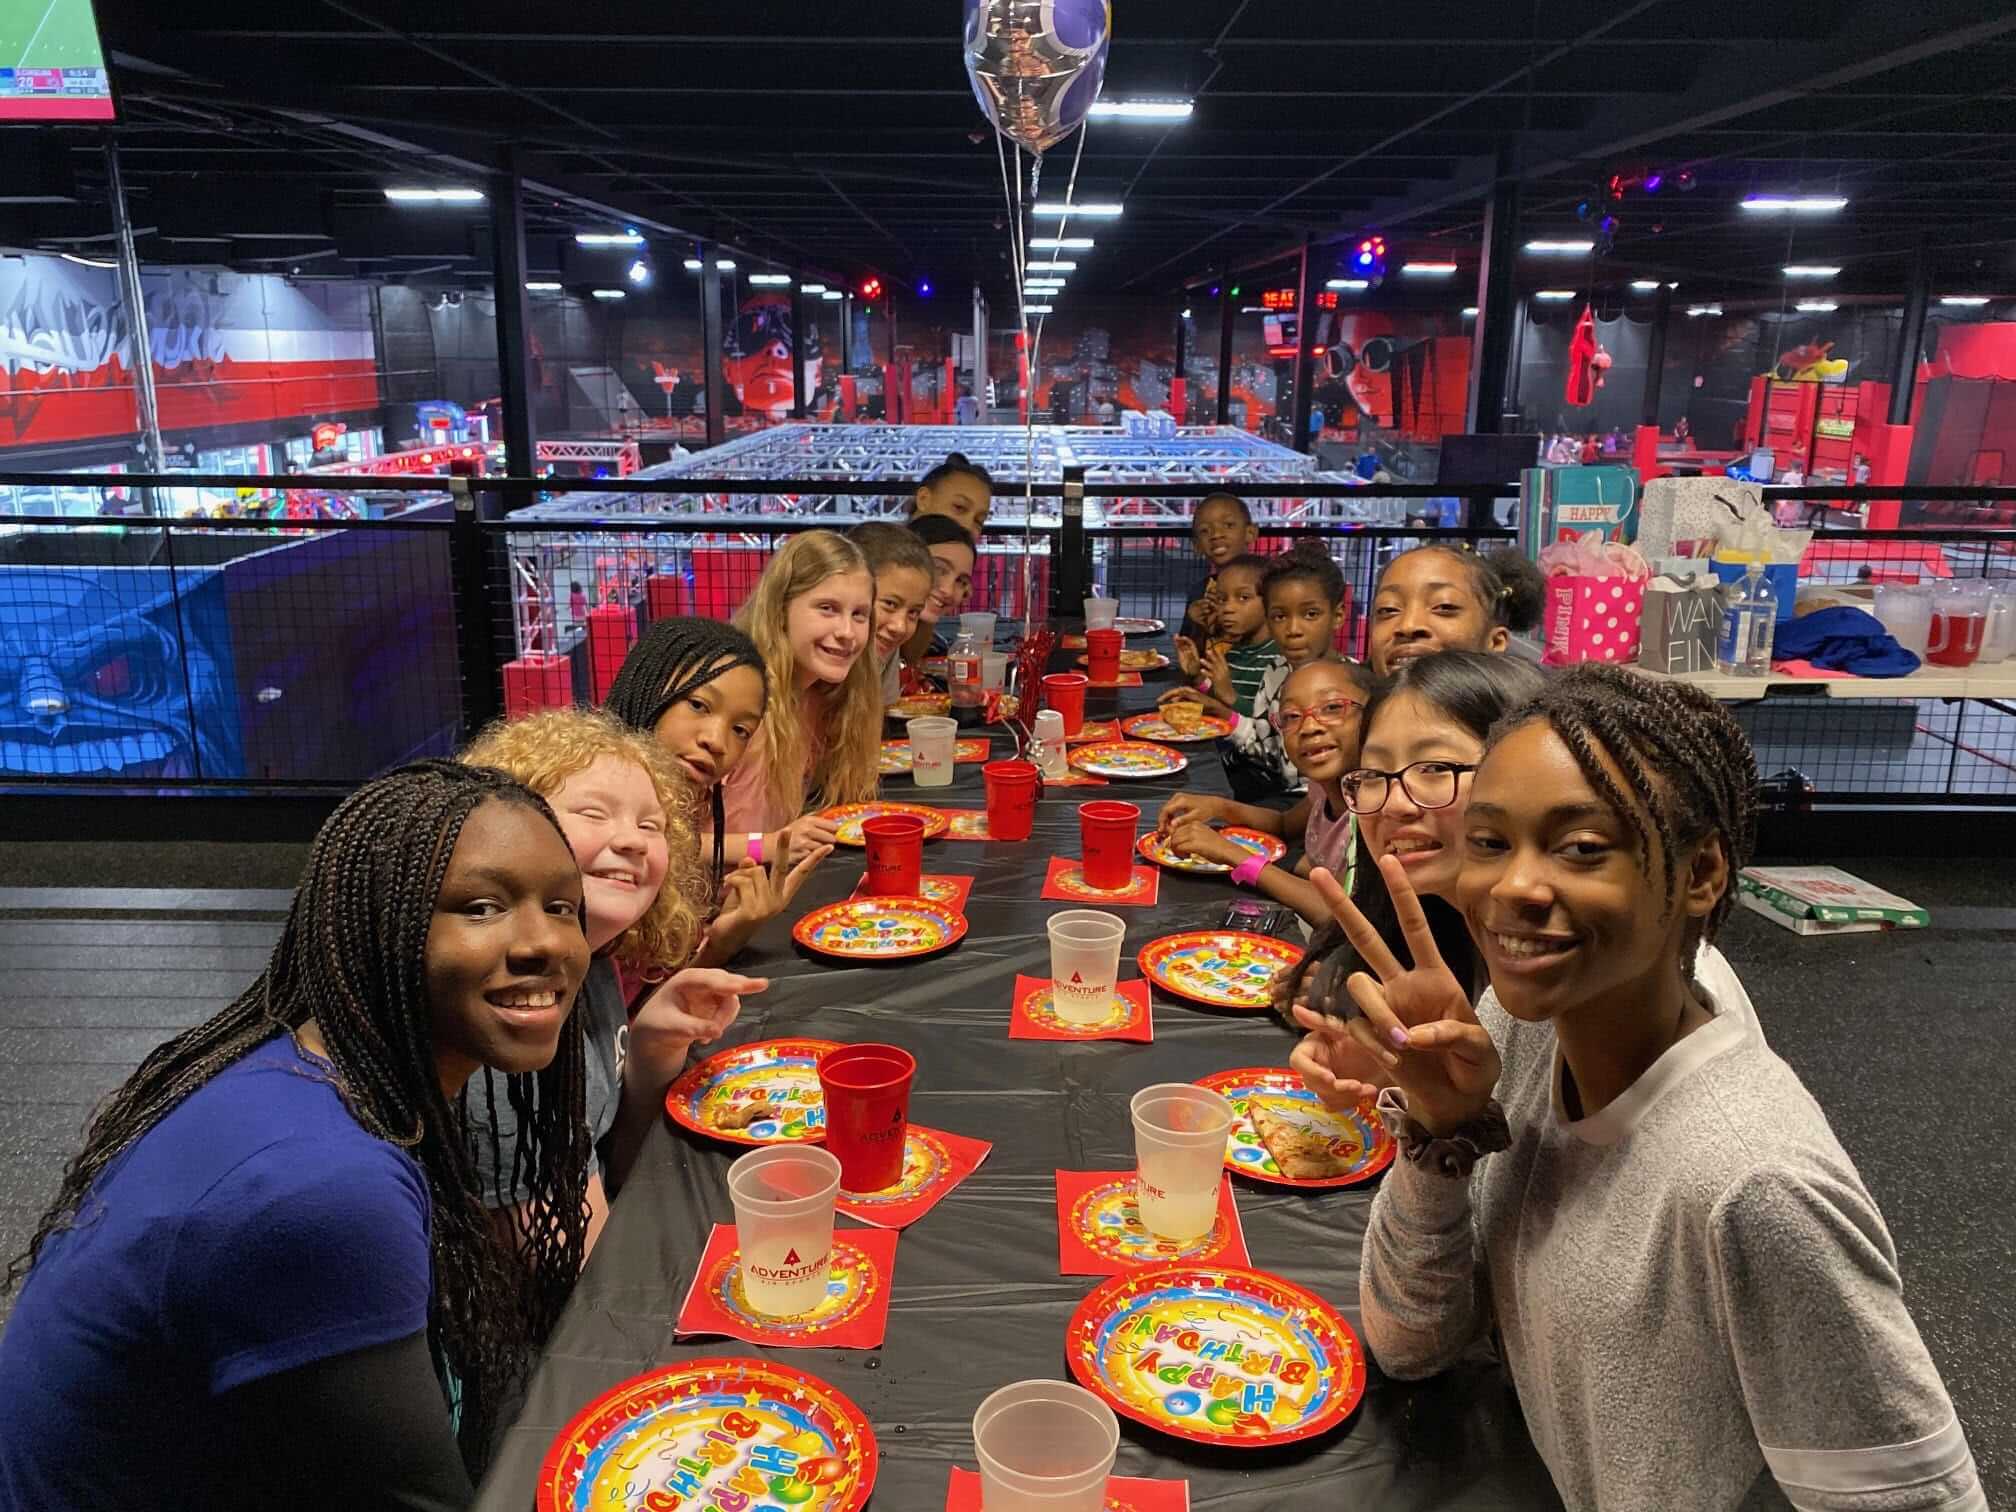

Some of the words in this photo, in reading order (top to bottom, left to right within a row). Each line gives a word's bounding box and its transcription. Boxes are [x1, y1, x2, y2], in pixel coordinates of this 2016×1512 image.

[1569, 507, 1612, 520] HAPPY
[1551, 586, 1574, 656] PINK
[1132, 1350, 1280, 1415] HAPPY
